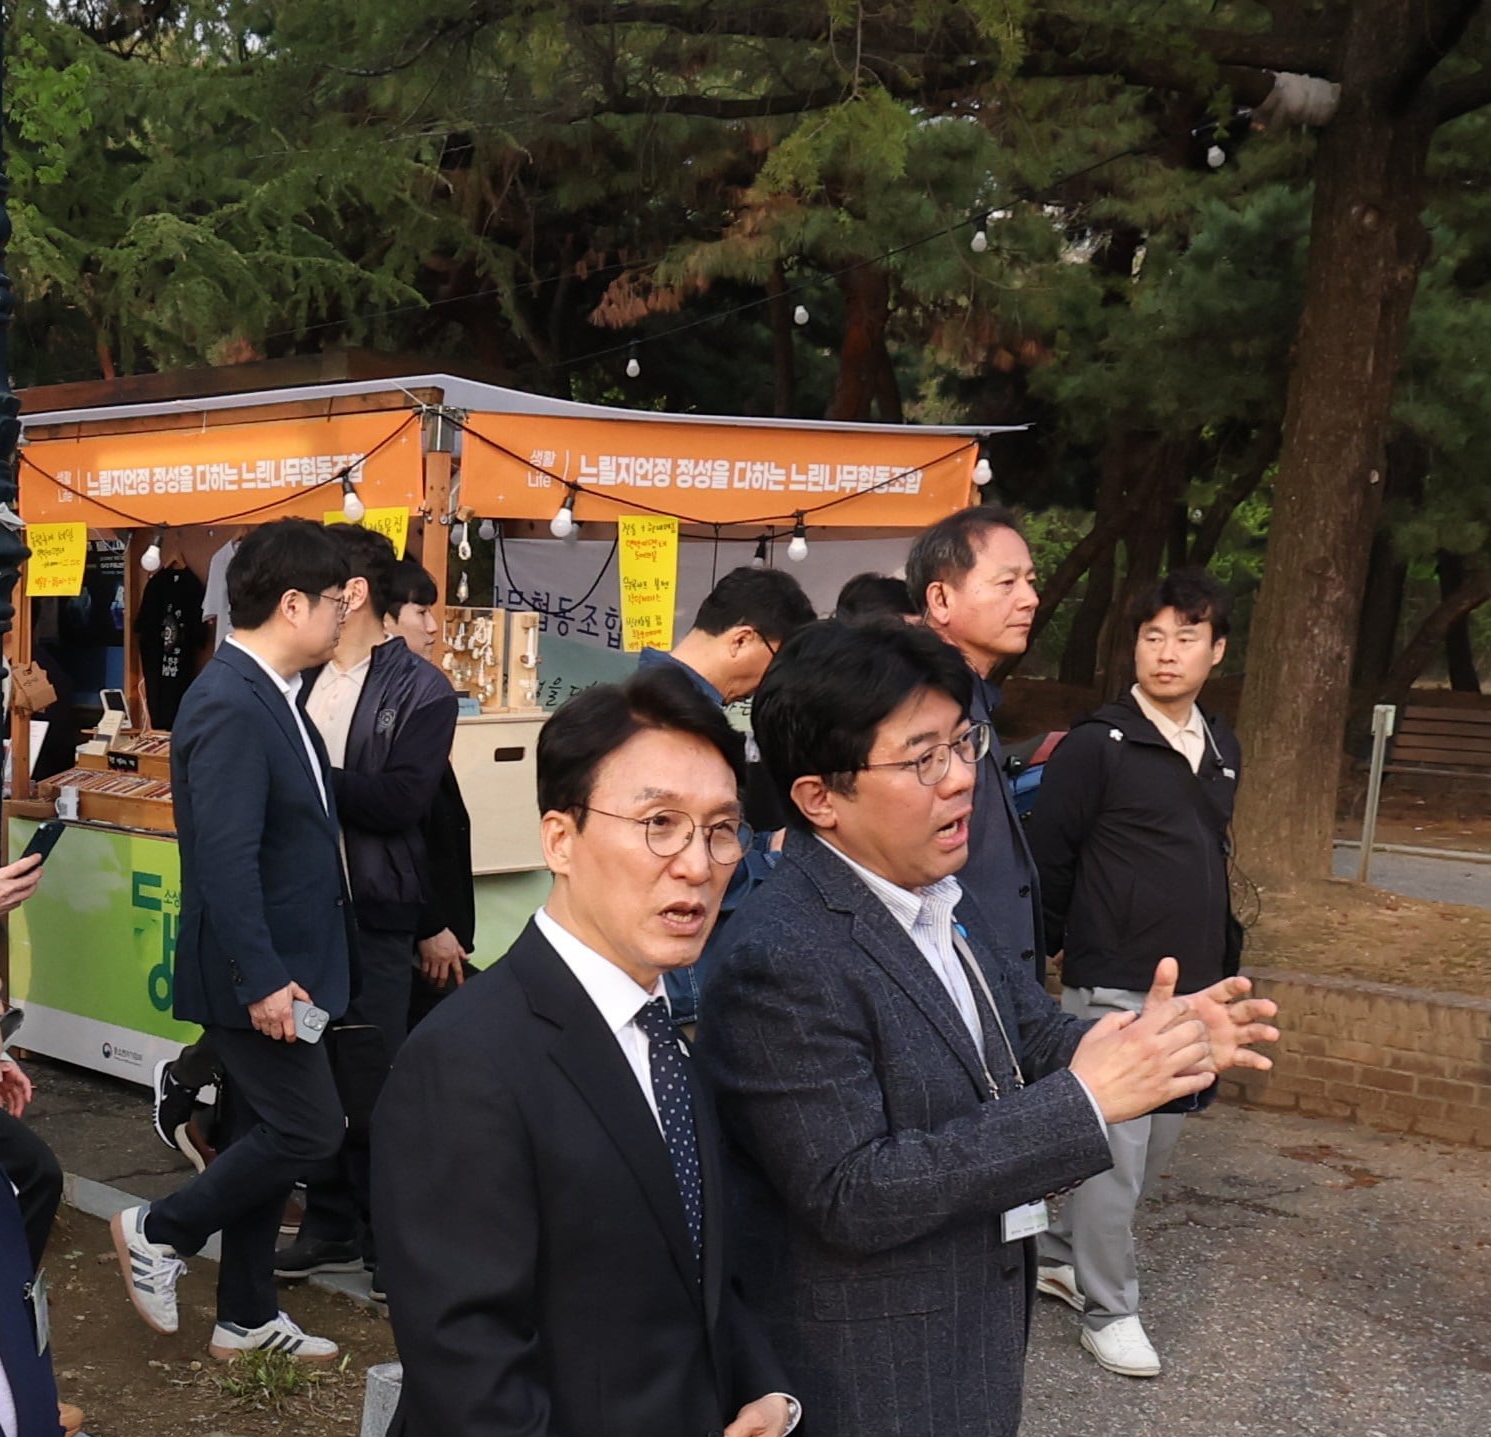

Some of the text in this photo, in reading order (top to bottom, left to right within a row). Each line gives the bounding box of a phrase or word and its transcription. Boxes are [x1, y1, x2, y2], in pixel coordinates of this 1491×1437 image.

[87, 453, 365, 497] 느릴지언정 정성을 다하는 느린나무협동조합
[527, 471, 552, 488] Life
[577, 454, 922, 494] 느릴지언정 정성을 다하는 느린나무협동조합
